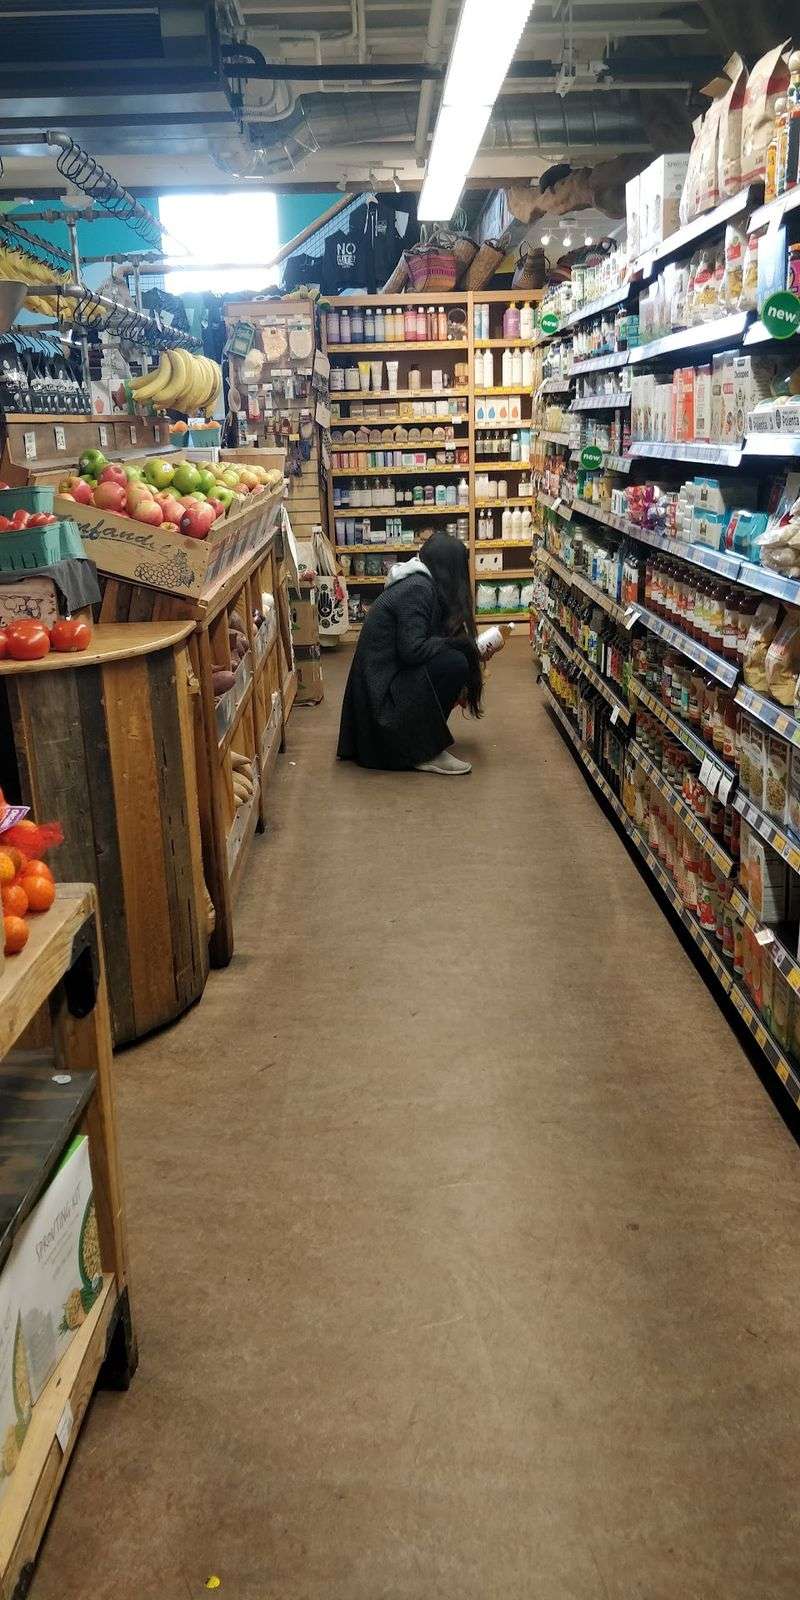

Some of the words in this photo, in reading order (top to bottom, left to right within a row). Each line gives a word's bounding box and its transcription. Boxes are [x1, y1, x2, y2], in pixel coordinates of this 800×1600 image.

[336, 242, 356, 255] NO
[768, 306, 796, 323] new
[583, 453, 600, 461] new
